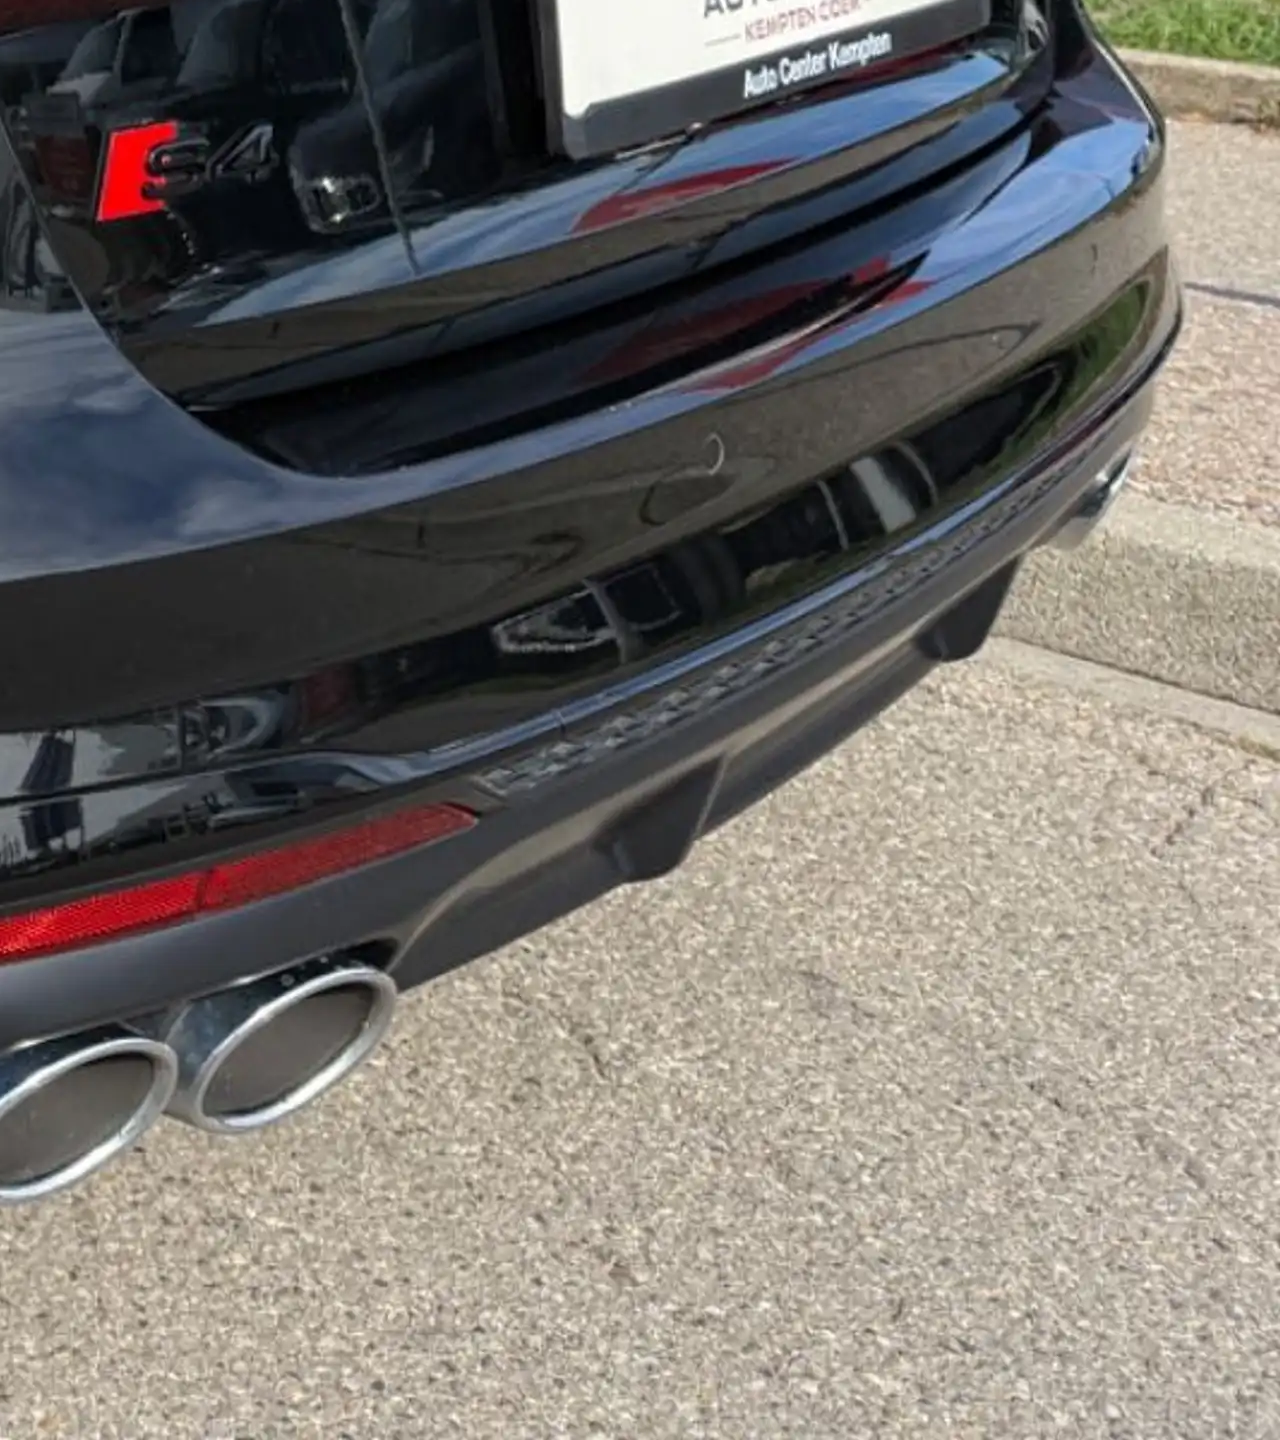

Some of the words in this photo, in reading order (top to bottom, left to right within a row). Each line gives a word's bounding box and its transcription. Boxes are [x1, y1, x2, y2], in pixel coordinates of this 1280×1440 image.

[745, 6, 817, 42] KEMPTEN
[743, 64, 776, 99] Auto
[779, 49, 827, 86] Center
[828, 30, 892, 71] Kempten
